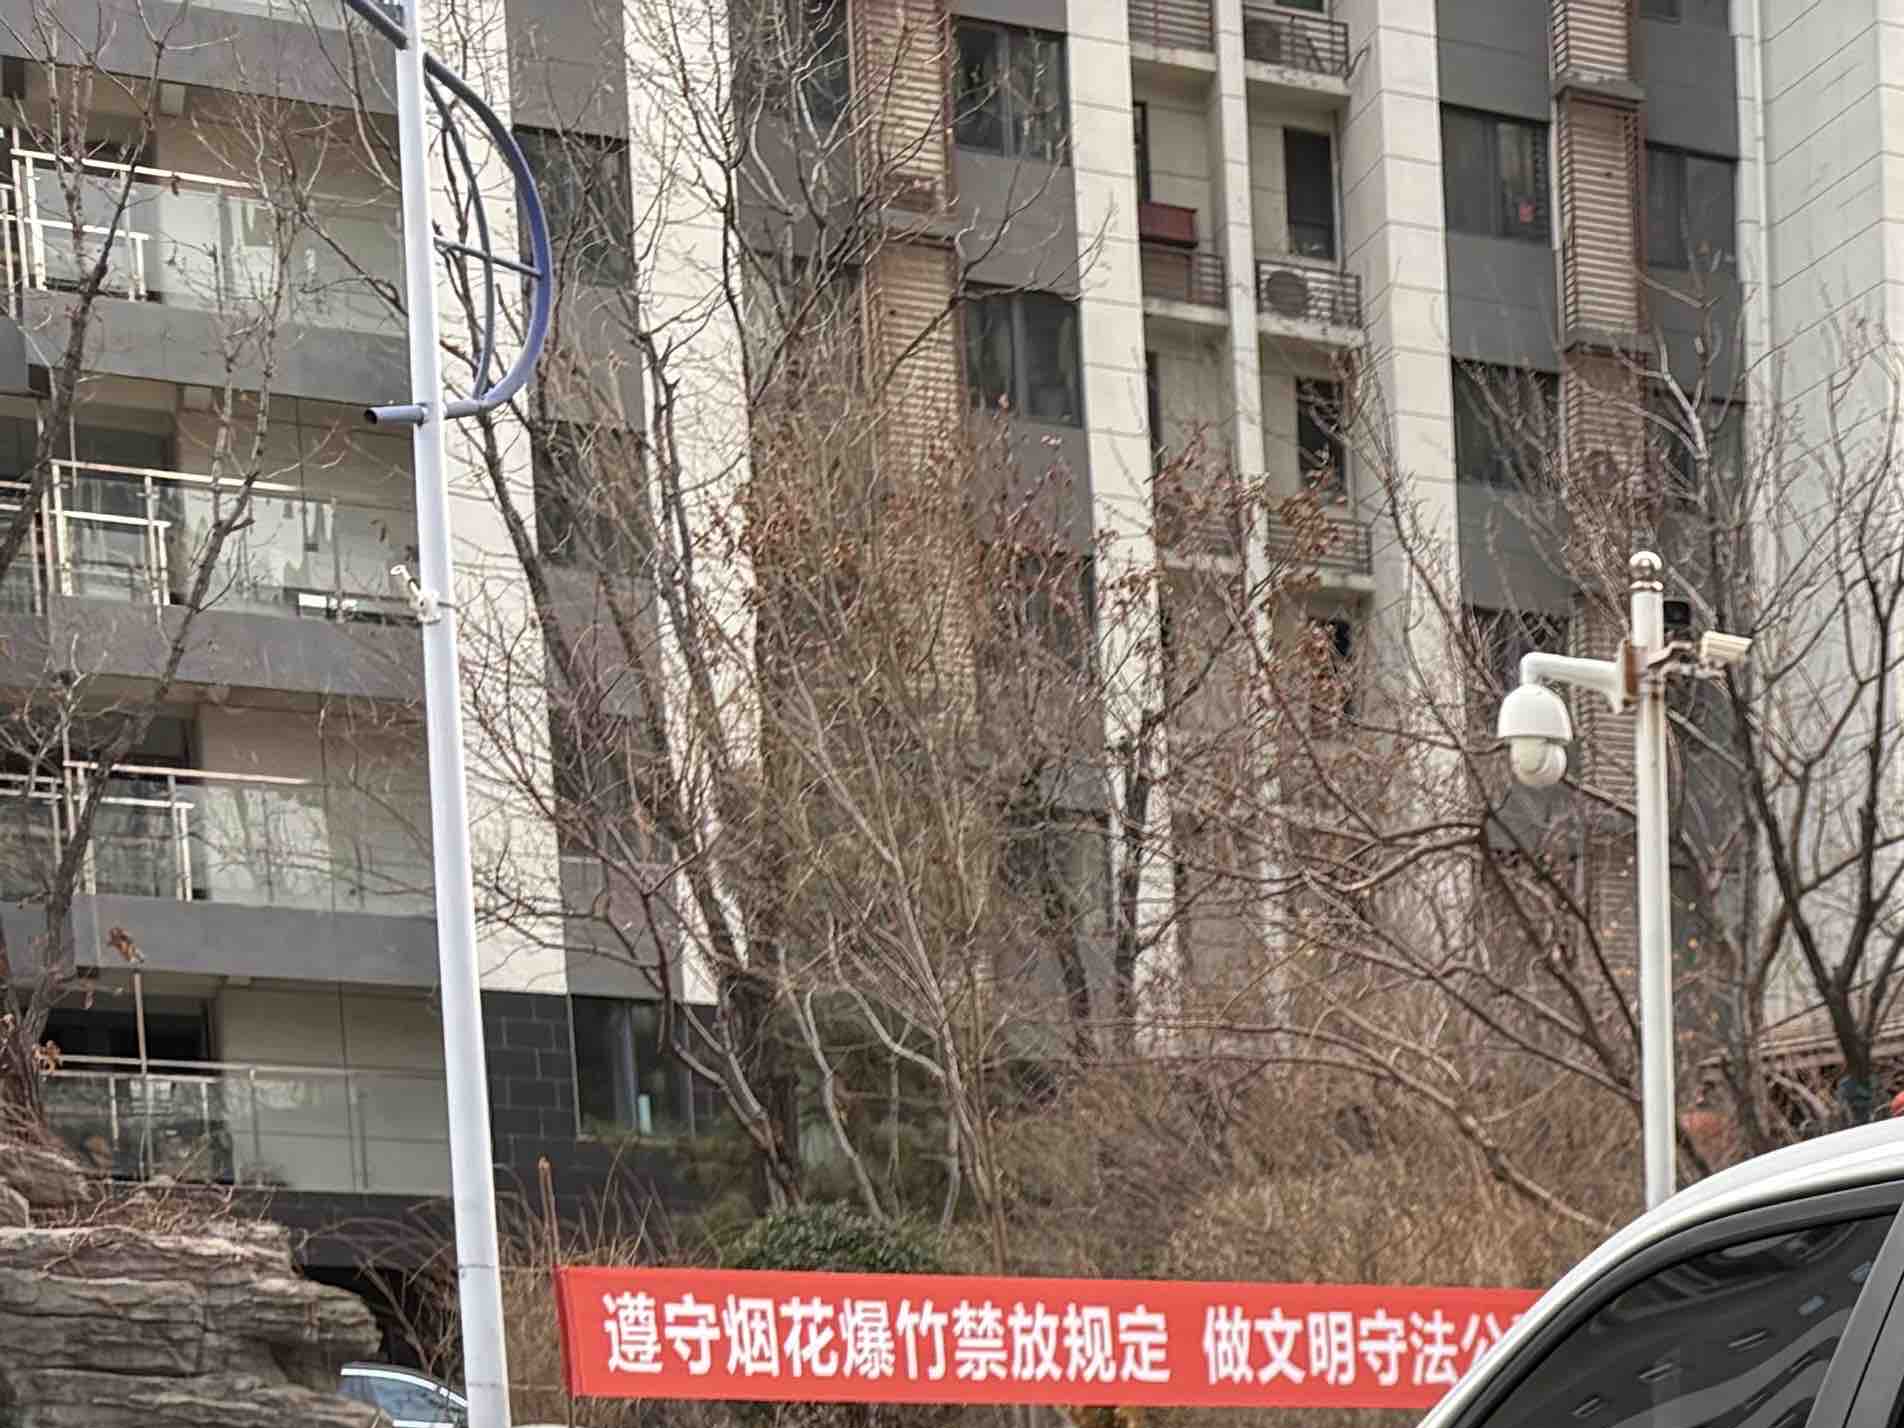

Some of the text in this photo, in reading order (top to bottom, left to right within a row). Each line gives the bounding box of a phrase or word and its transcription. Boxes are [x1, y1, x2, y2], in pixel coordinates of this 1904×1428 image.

[602, 1291, 1525, 1387] 遵守烟花爆竹禁放规定 做文明守法公
